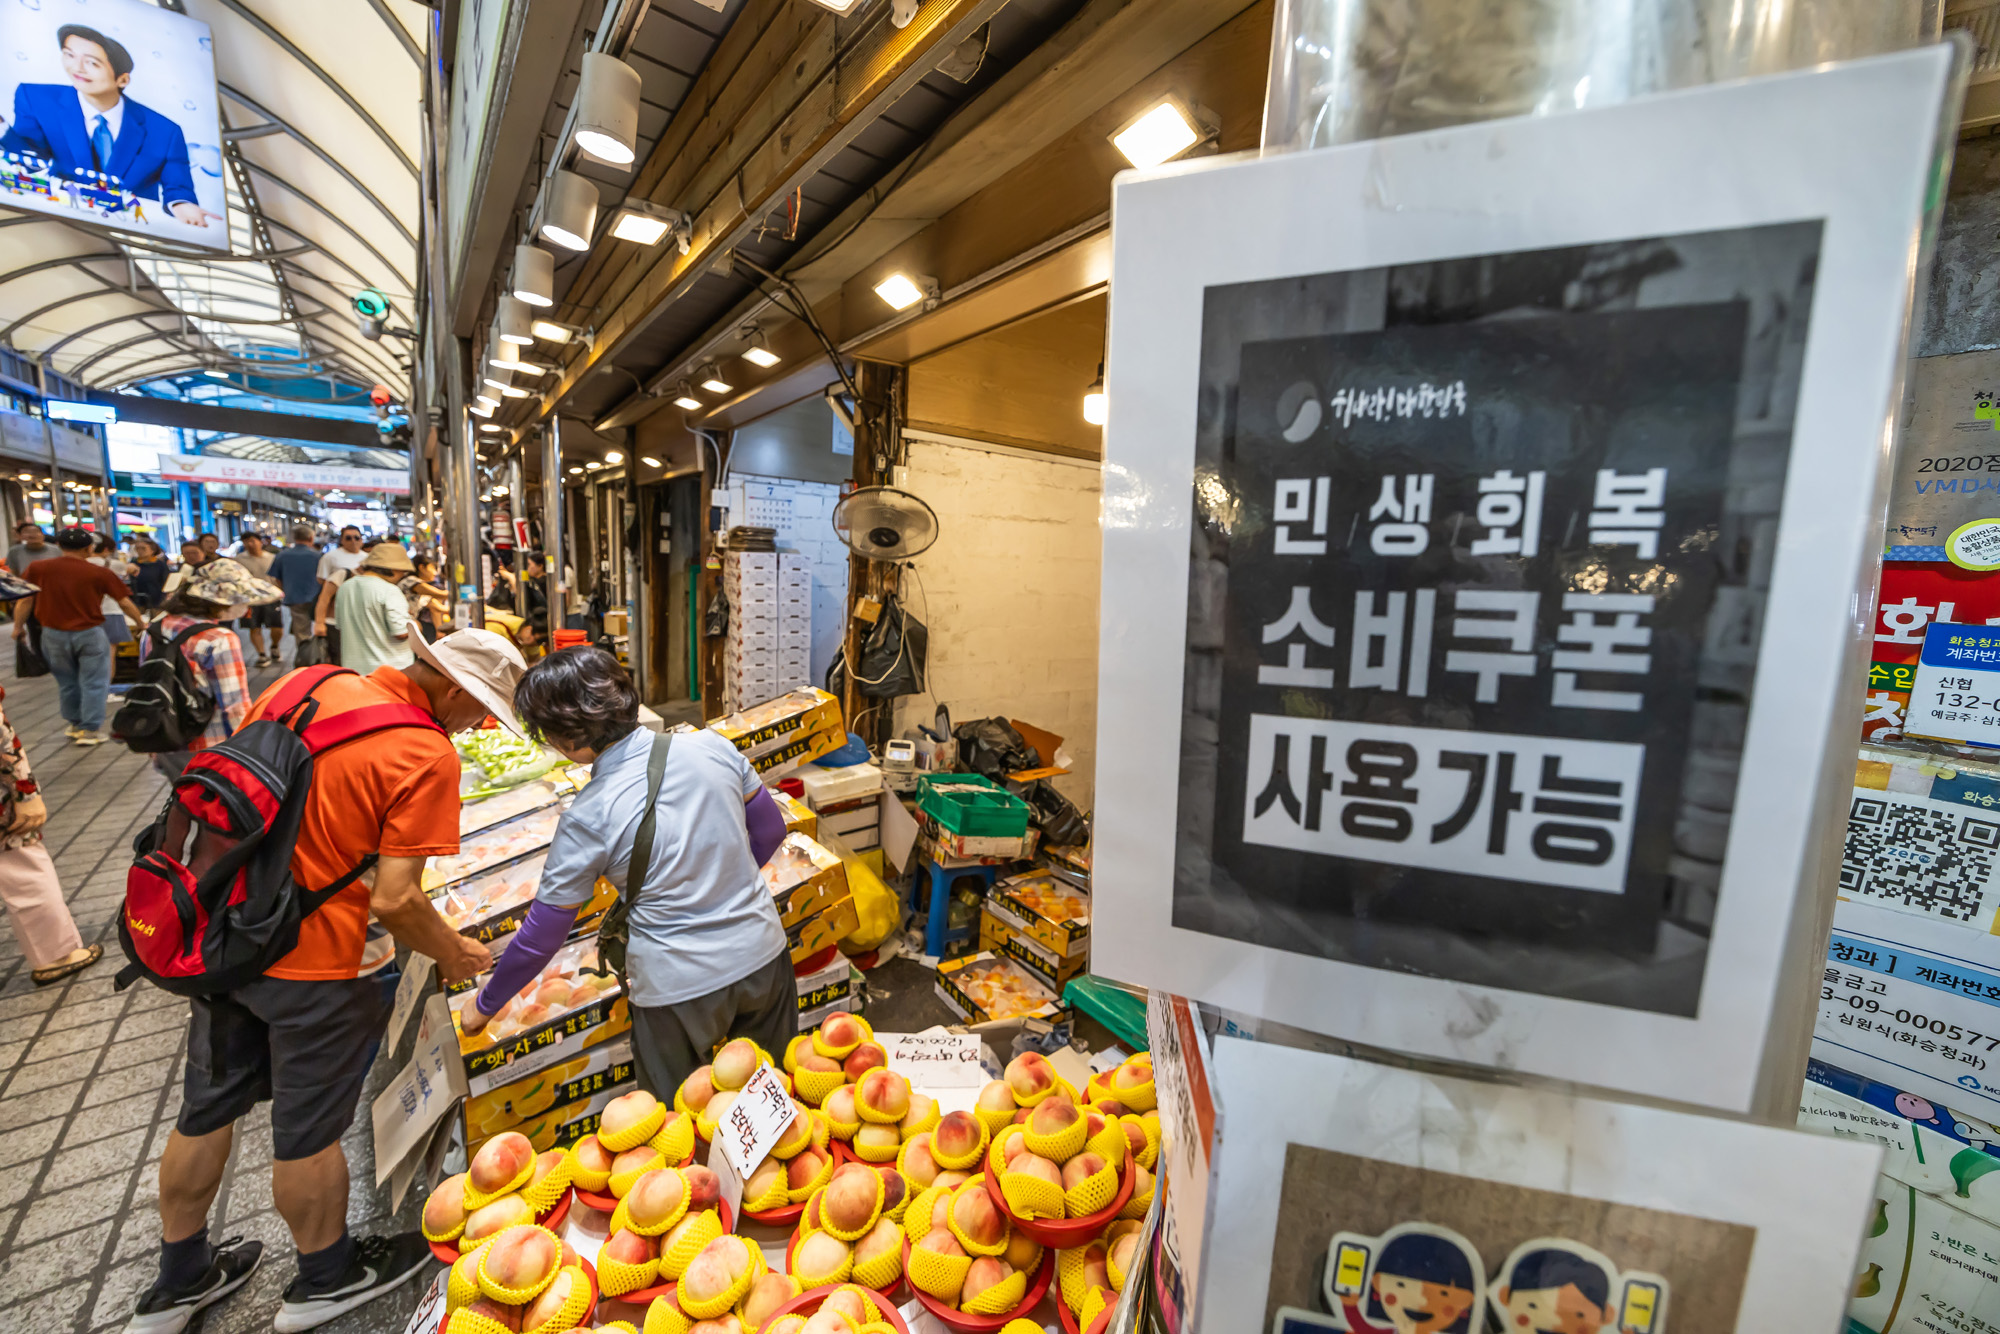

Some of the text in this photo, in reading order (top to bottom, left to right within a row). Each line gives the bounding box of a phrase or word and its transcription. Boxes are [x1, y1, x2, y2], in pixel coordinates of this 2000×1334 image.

[1257, 586, 1657, 713] 소비쿠폰
[1938, 677, 1973, 691] 신협
[1253, 733, 1625, 868] 사용가능
[1828, 942, 1880, 967] 청과
